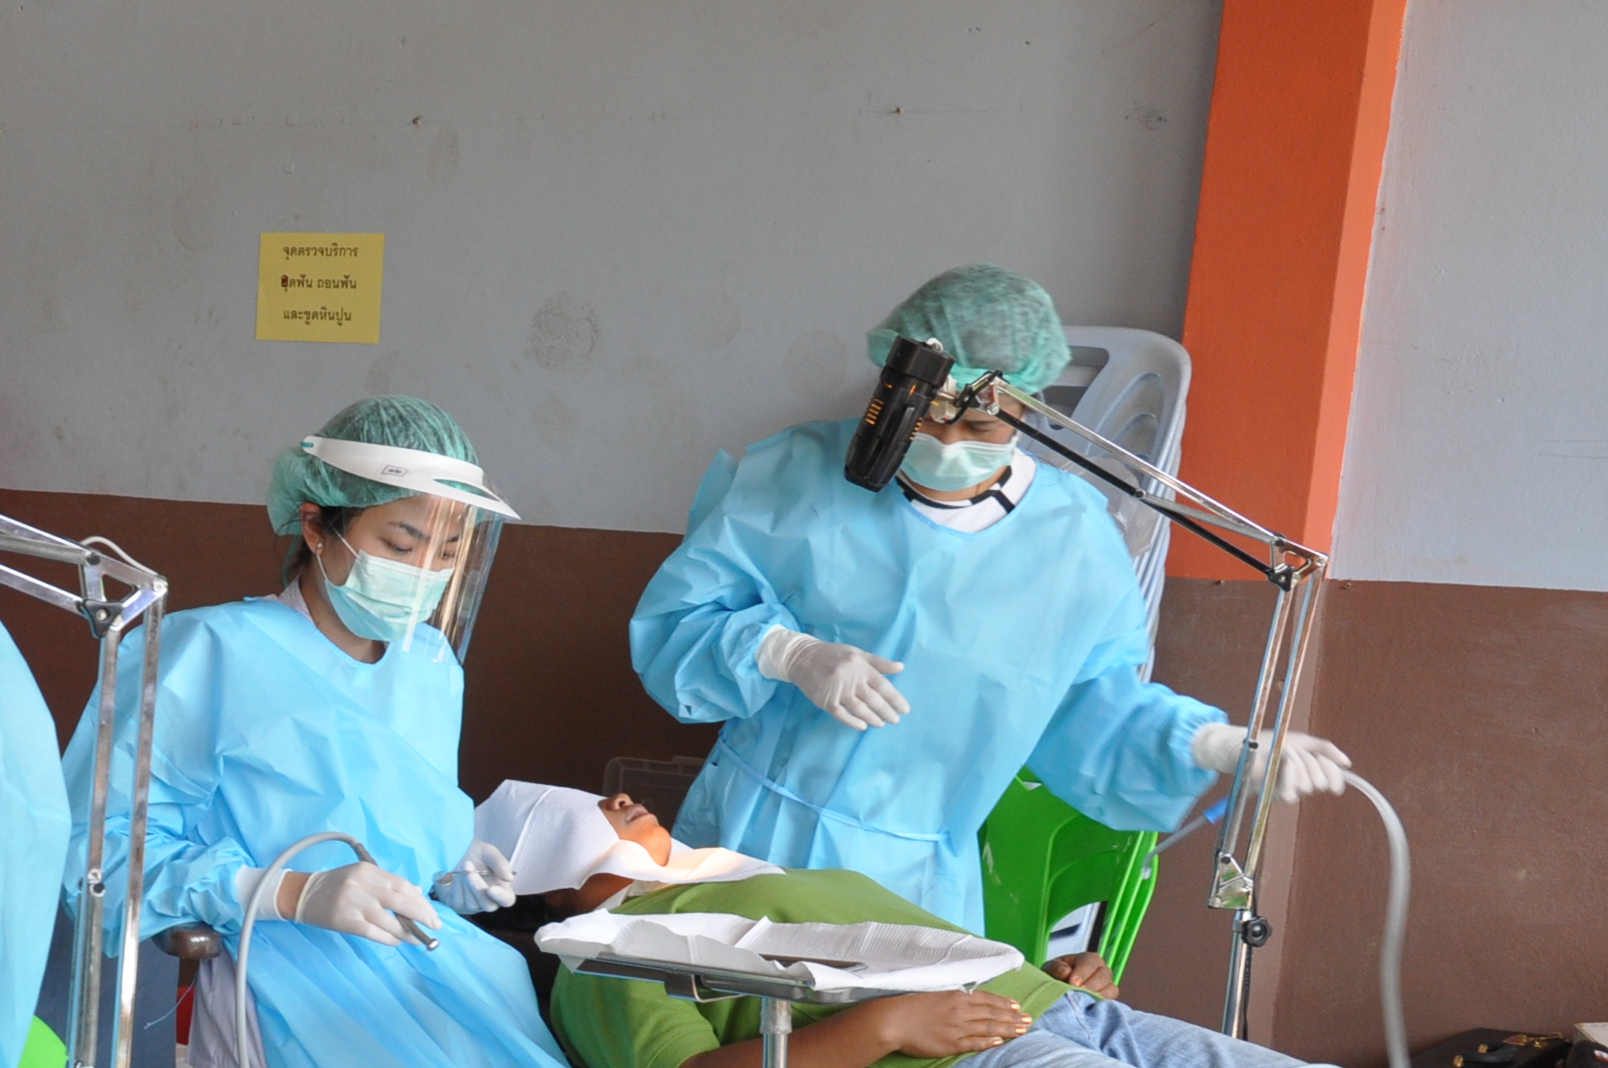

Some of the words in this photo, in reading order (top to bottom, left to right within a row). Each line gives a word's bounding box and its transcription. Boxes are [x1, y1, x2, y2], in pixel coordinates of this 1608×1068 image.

[283, 242, 359, 260] จุดตรวจบริการ
[317, 273, 357, 290] ถอนฟัน
[283, 306, 352, 325] และขูดหินปูน
